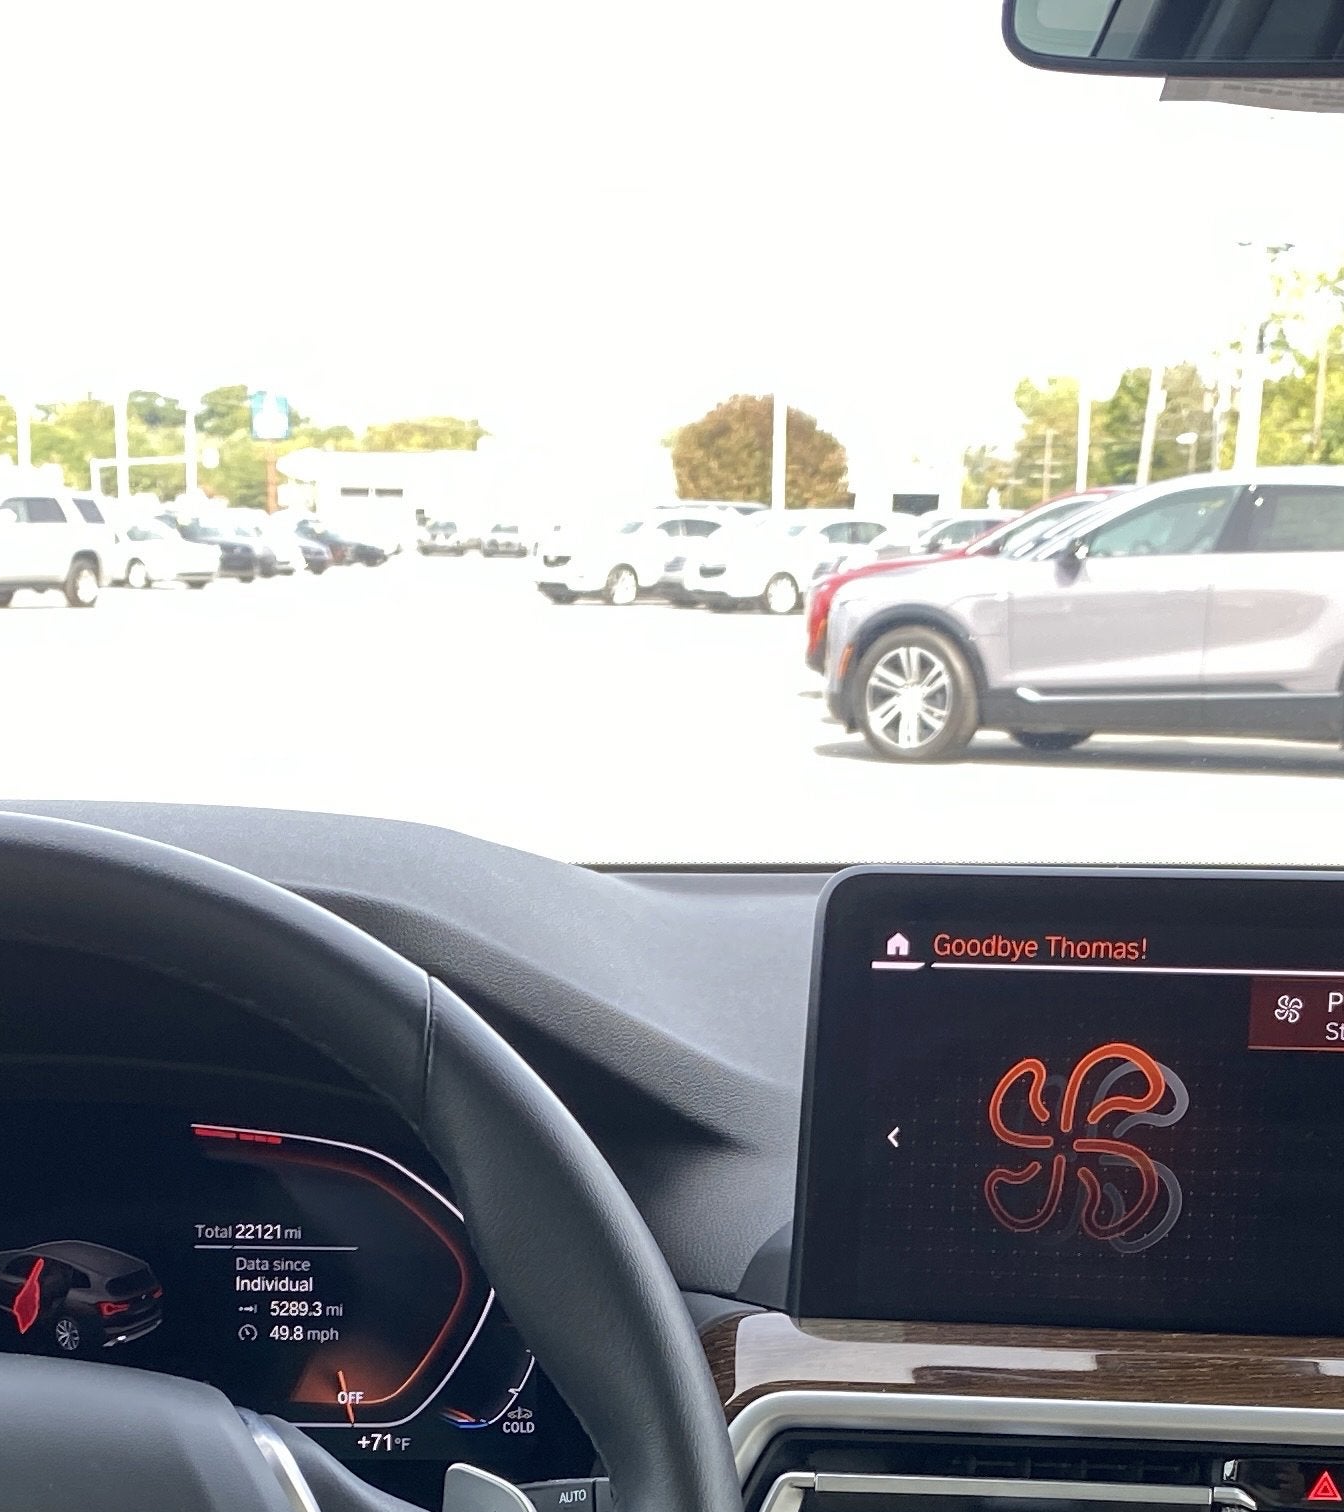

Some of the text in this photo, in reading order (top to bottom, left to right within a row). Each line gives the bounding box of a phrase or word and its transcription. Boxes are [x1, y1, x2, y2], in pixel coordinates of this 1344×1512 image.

[933, 933, 1148, 963] Goodbye Thomas!
[194, 1223, 302, 1241] Total 22121 mi
[235, 1256, 312, 1273] Data since
[235, 1275, 315, 1293] Individual
[269, 1301, 344, 1318] 5289.3 mi
[269, 1325, 341, 1345] 49.8 mph
[336, 1391, 365, 1405] OFF
[502, 1420, 536, 1434] COLD
[558, 1488, 588, 1505] AUTO
